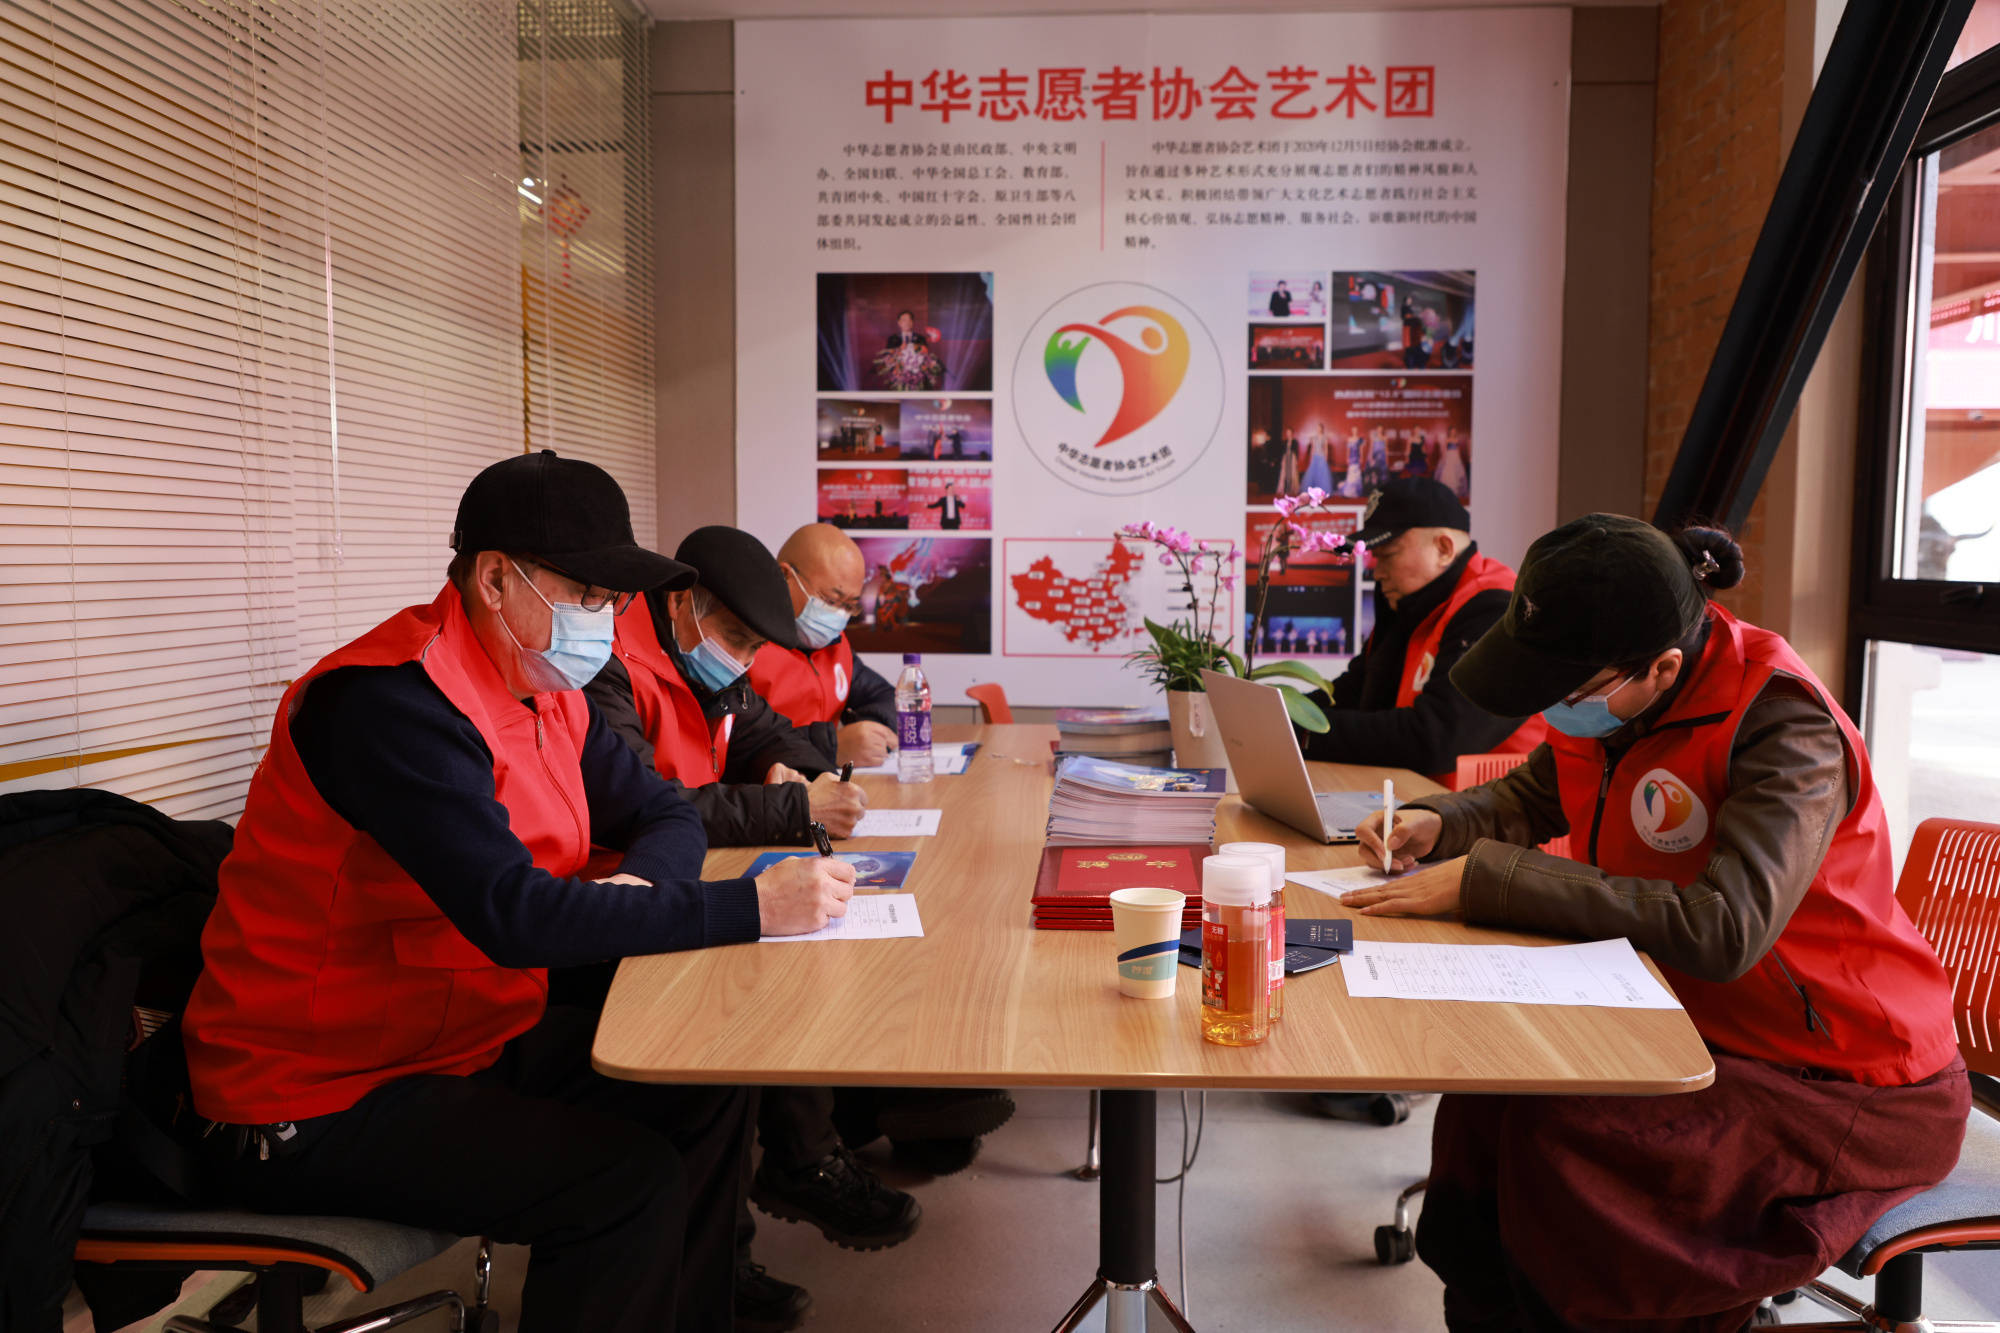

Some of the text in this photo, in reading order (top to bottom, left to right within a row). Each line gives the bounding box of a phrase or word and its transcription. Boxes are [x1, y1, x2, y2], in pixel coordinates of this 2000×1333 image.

[865, 64, 1436, 124] 中华志愿者协会艺术团
[1058, 442, 1173, 472] 中华志愿者协会艺术团
